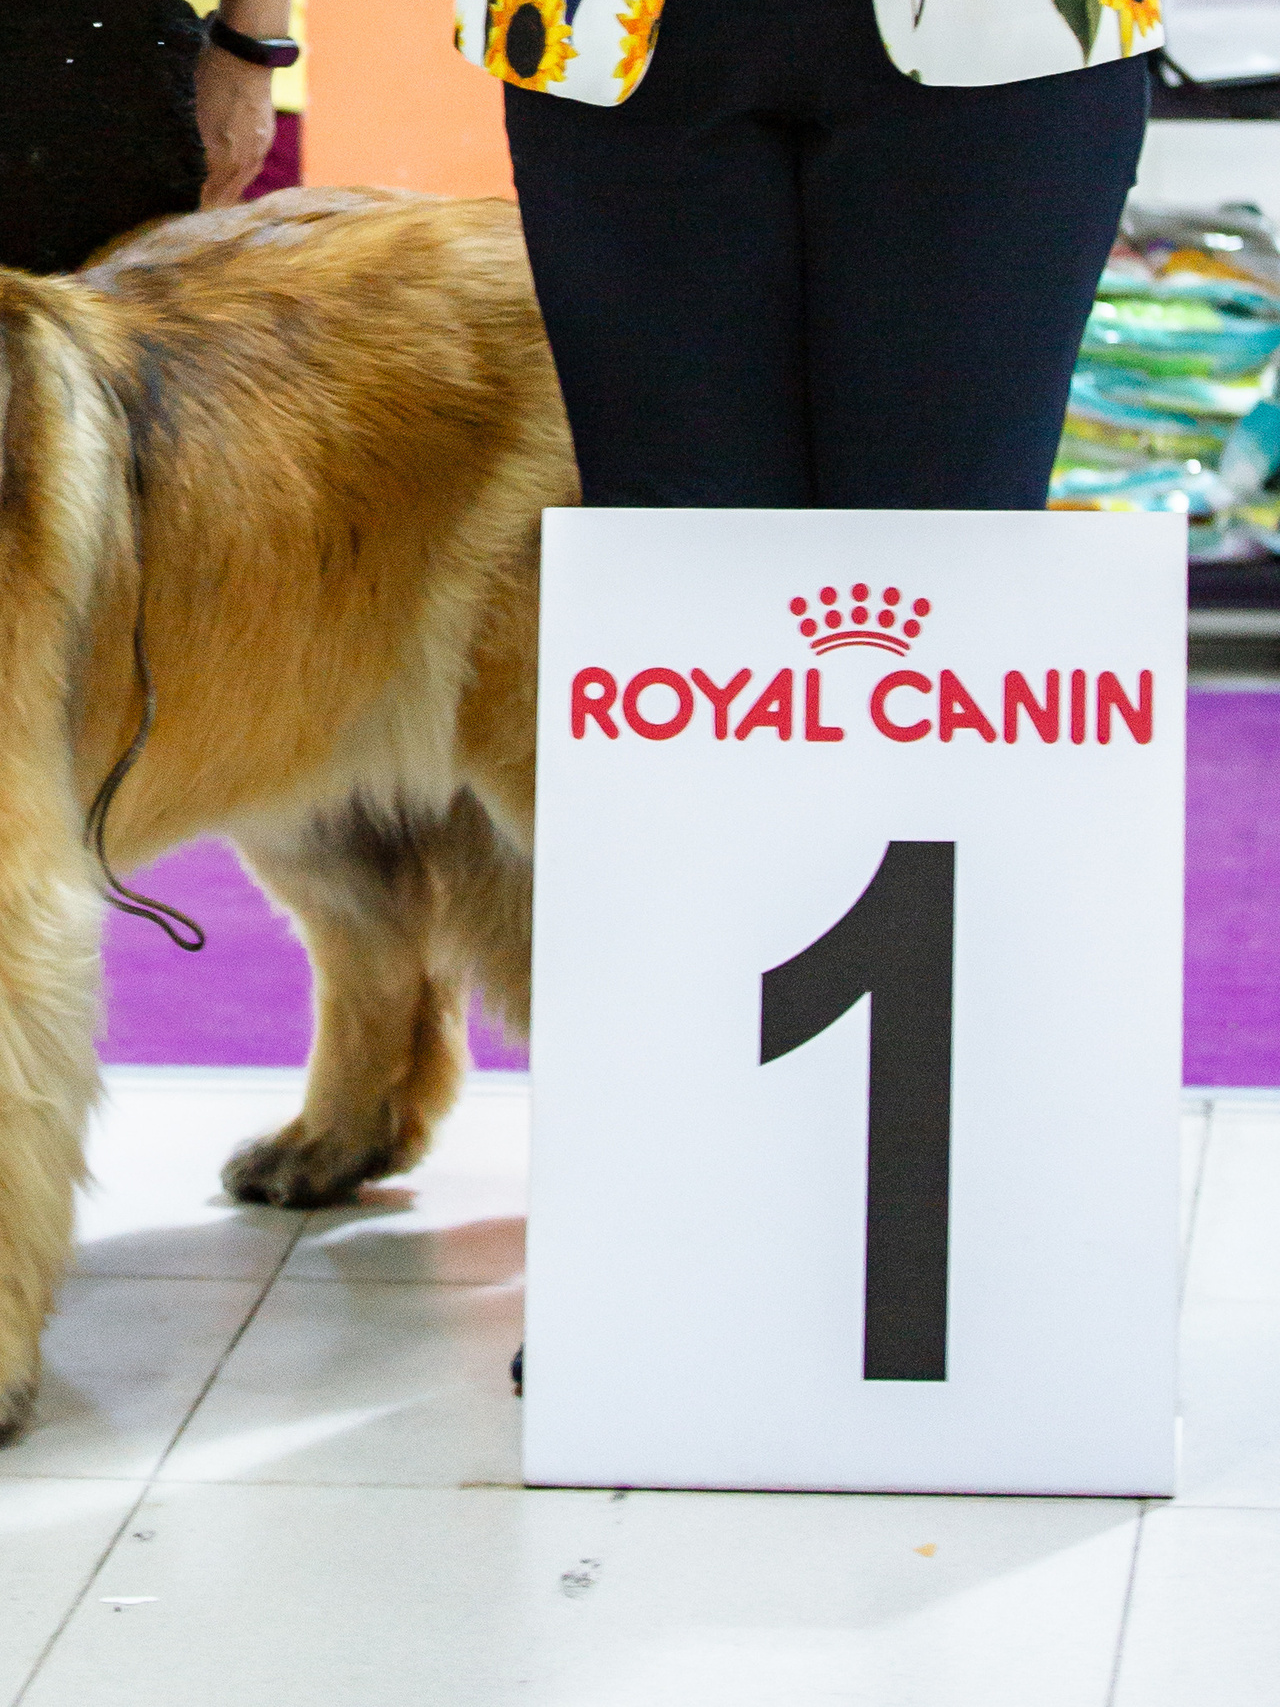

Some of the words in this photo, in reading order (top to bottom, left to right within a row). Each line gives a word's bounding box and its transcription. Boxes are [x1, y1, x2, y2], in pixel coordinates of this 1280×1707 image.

[570, 665, 844, 743] ROYAL
[869, 667, 1154, 746] CANIN
[759, 840, 957, 1382] 1
